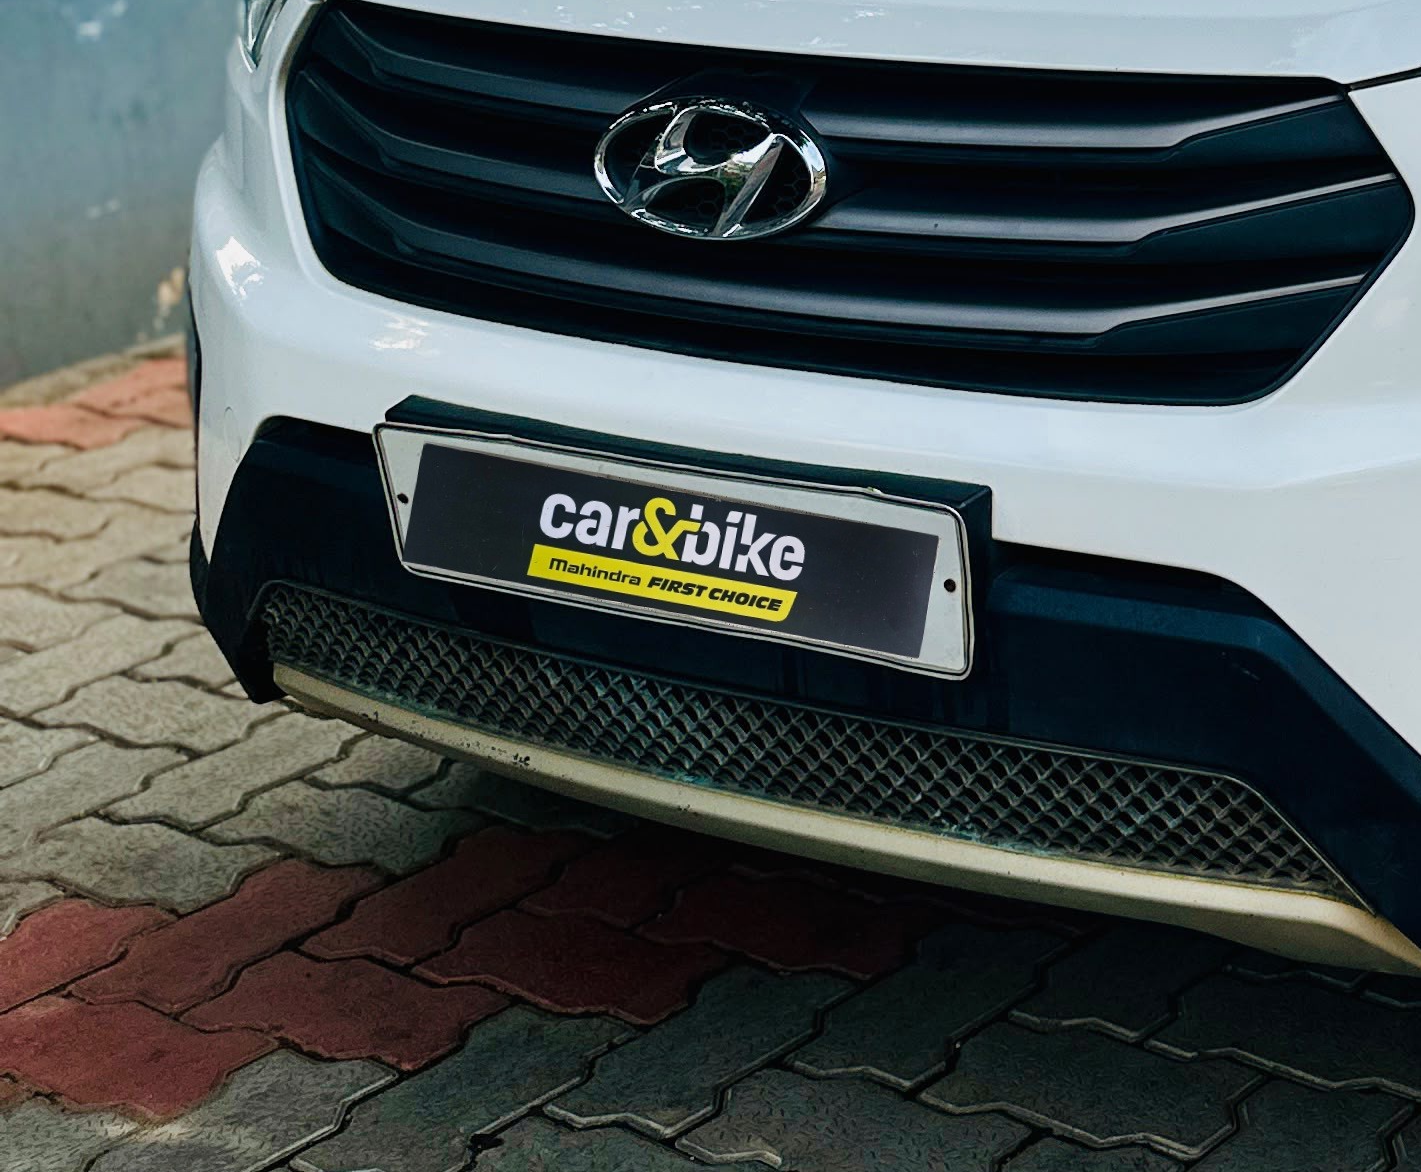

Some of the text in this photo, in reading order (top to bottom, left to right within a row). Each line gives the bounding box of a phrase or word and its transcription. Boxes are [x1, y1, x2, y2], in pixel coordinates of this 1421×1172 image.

[539, 493, 806, 581] car&bike
[549, 558, 783, 612] Mahindra FIRST CHOICE
